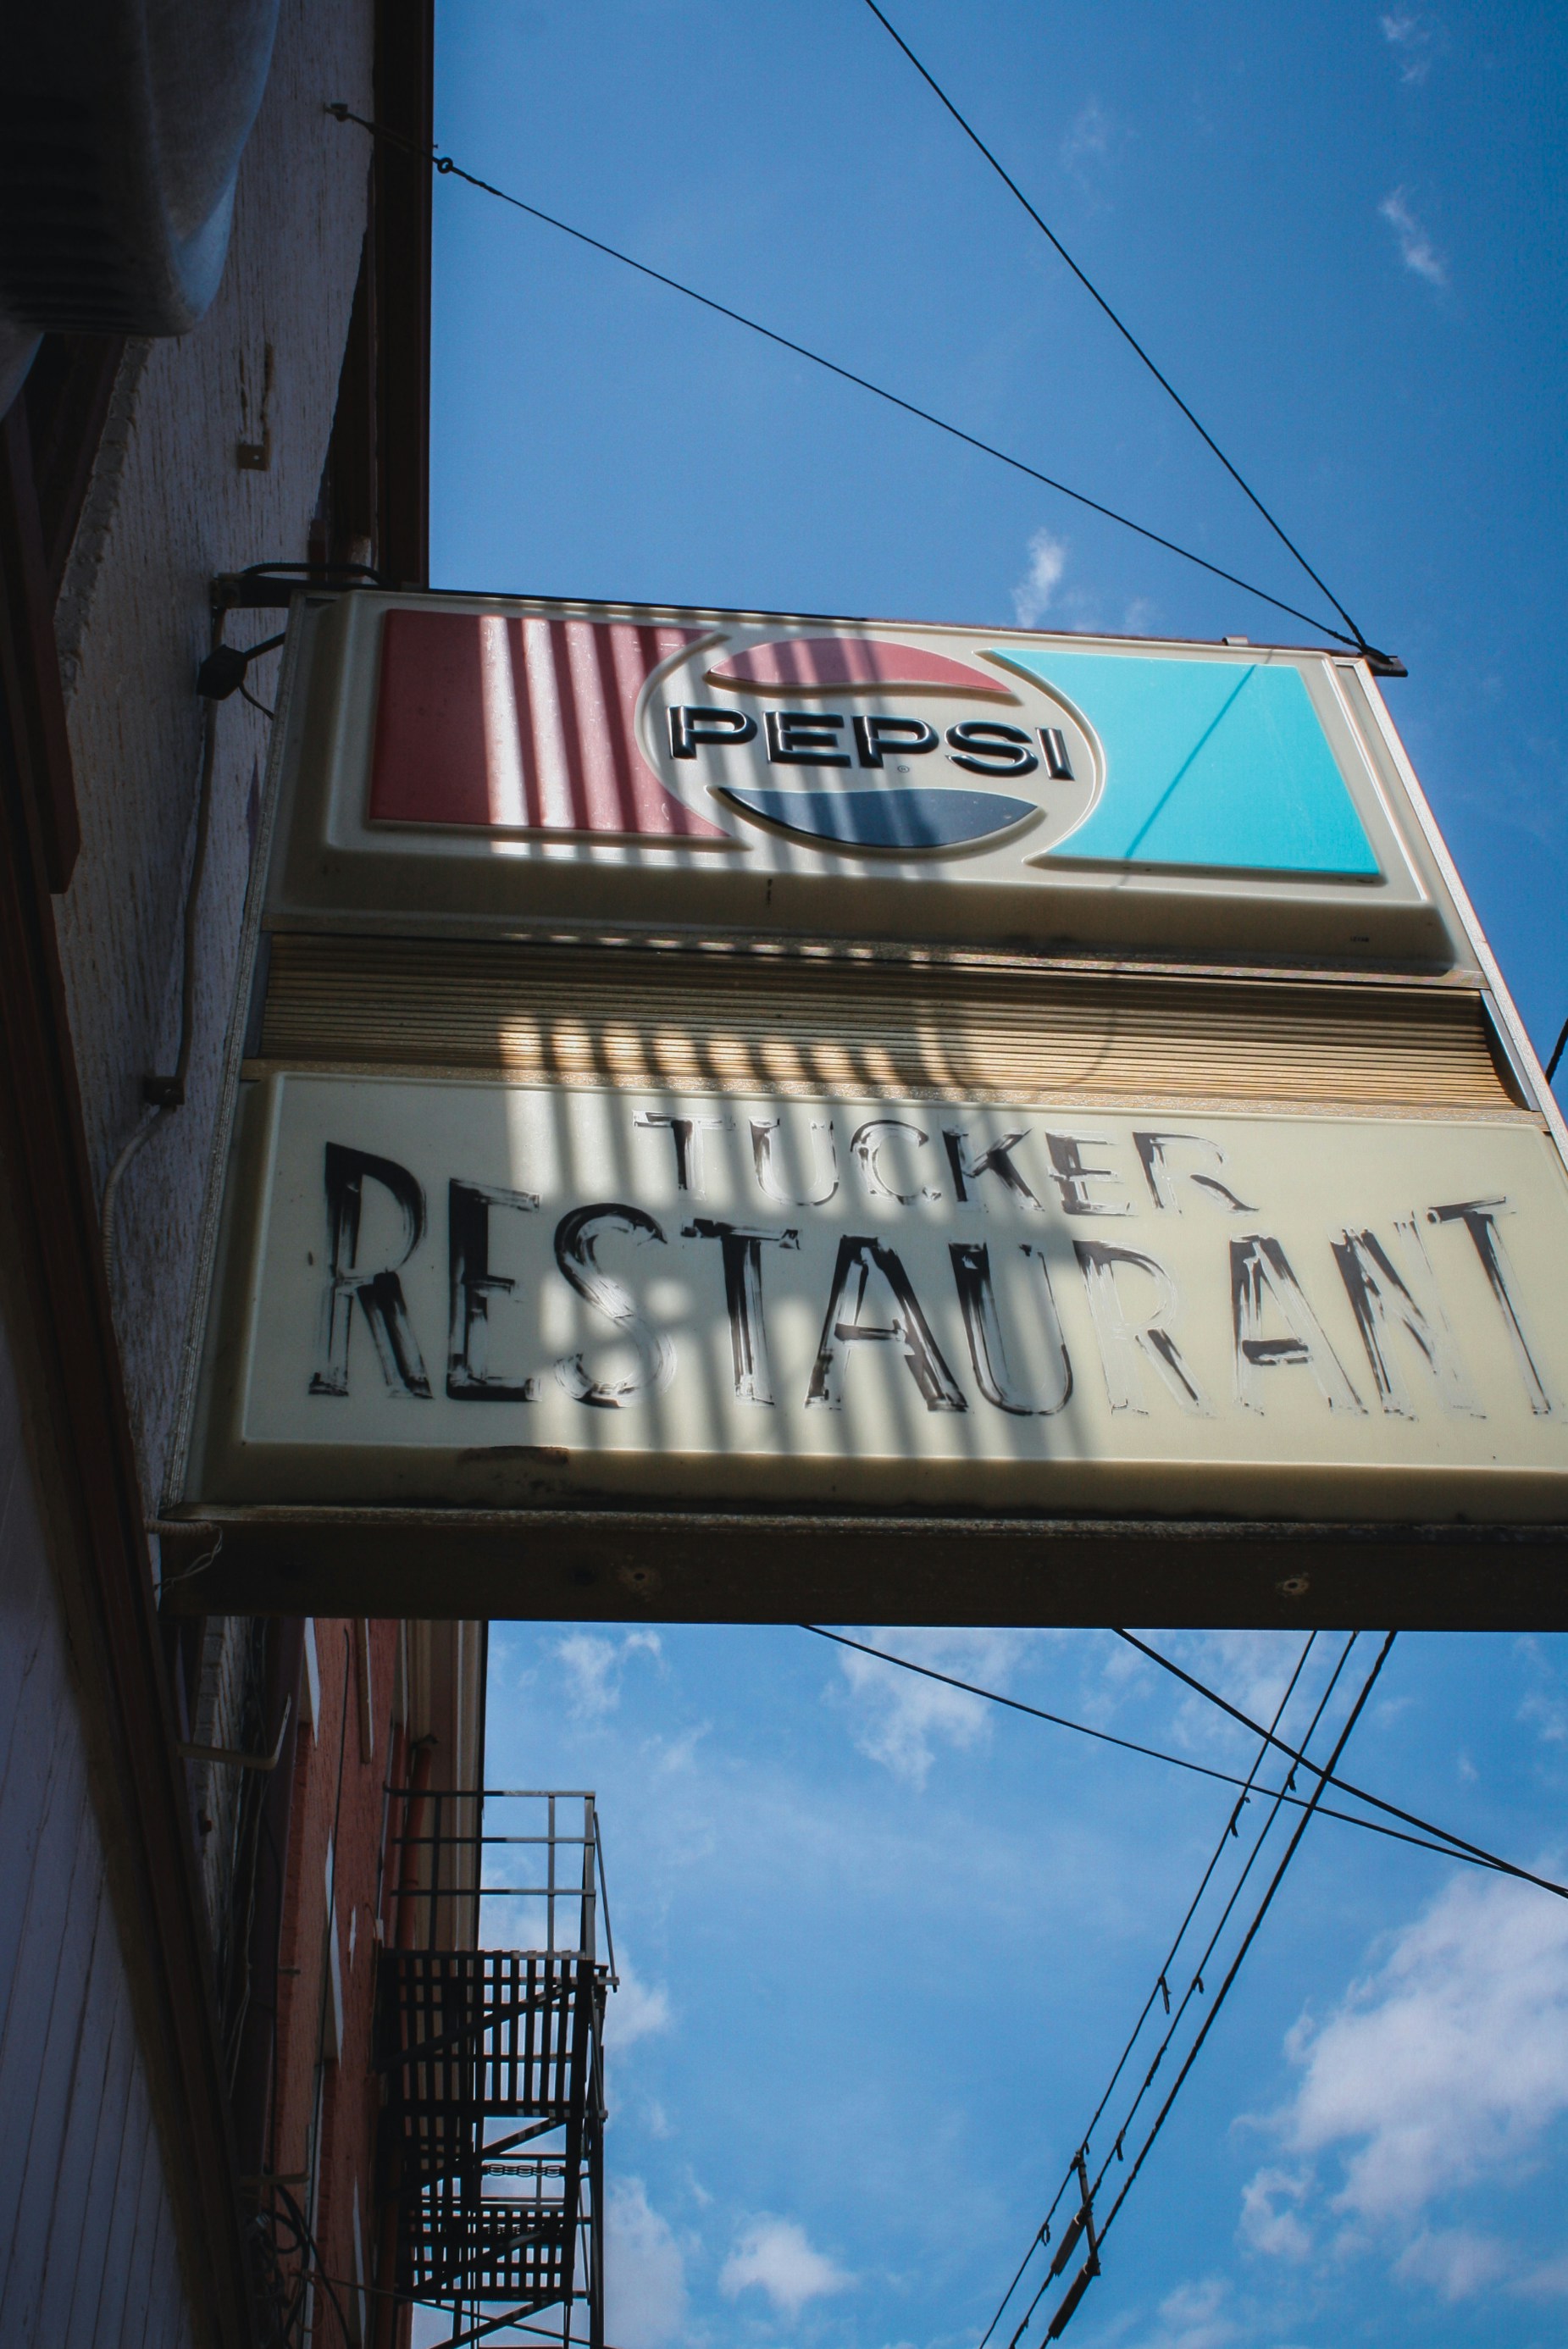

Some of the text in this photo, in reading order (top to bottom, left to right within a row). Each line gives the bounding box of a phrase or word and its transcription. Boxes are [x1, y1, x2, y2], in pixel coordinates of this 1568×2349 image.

[667, 705, 1074, 781] PEPSI
[632, 1109, 1260, 1216] TUCKER
[308, 1141, 1565, 1421] RESTAURANT
